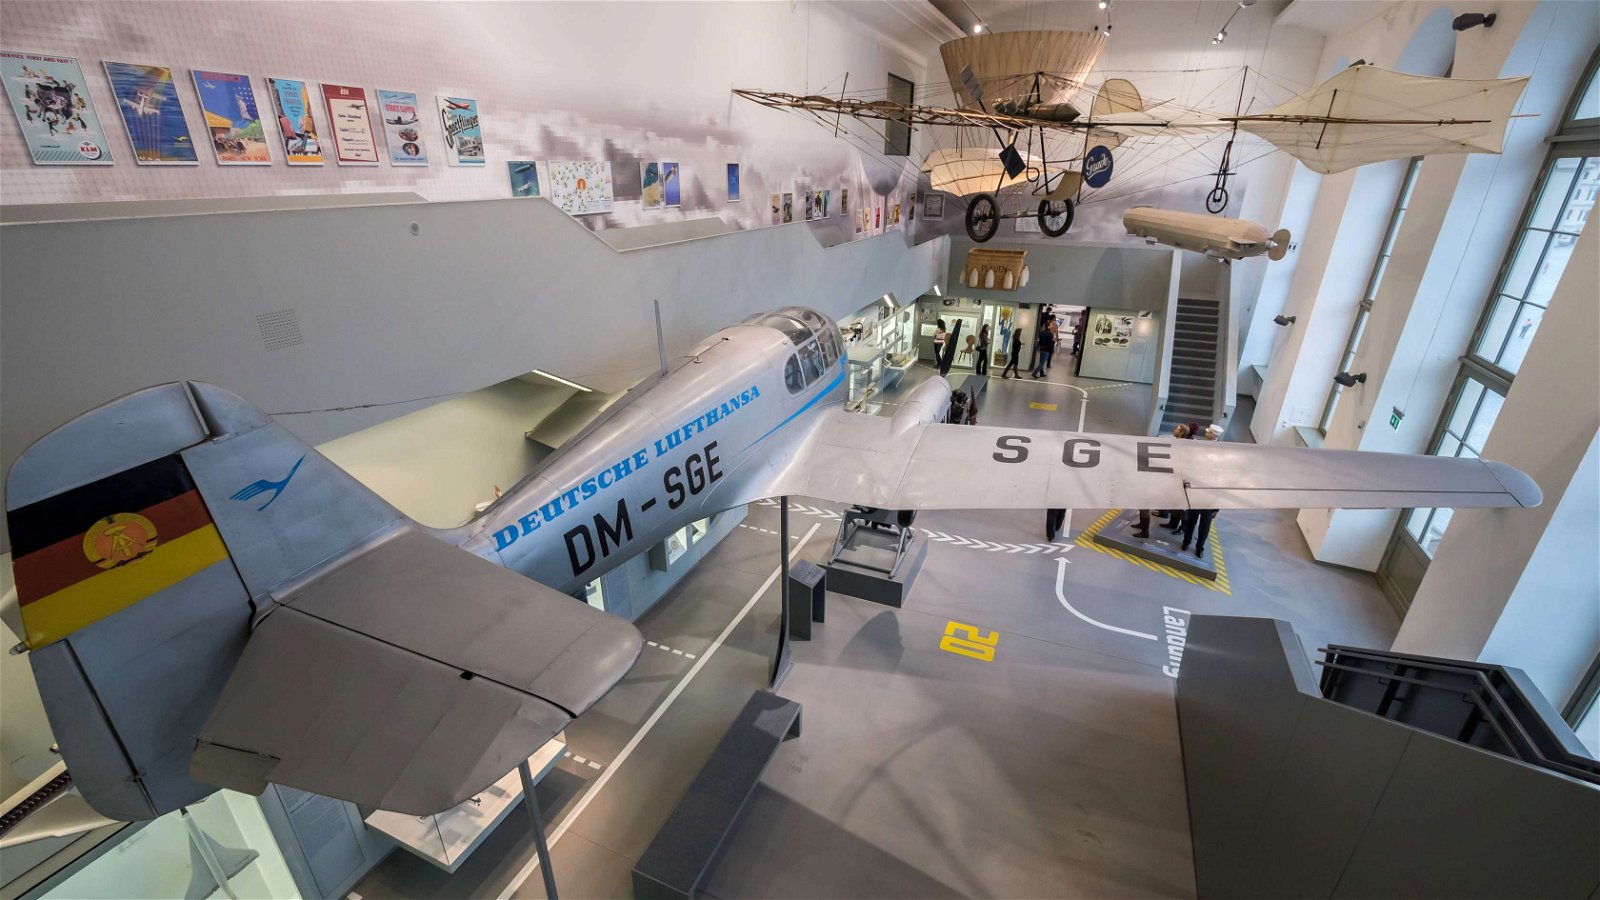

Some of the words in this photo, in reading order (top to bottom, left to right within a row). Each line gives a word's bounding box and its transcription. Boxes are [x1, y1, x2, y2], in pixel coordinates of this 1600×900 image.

[981, 264, 1008, 273] PUEN
[491, 448, 649, 552] DEUTSCHE
[654, 385, 760, 458] LUFTHANSA
